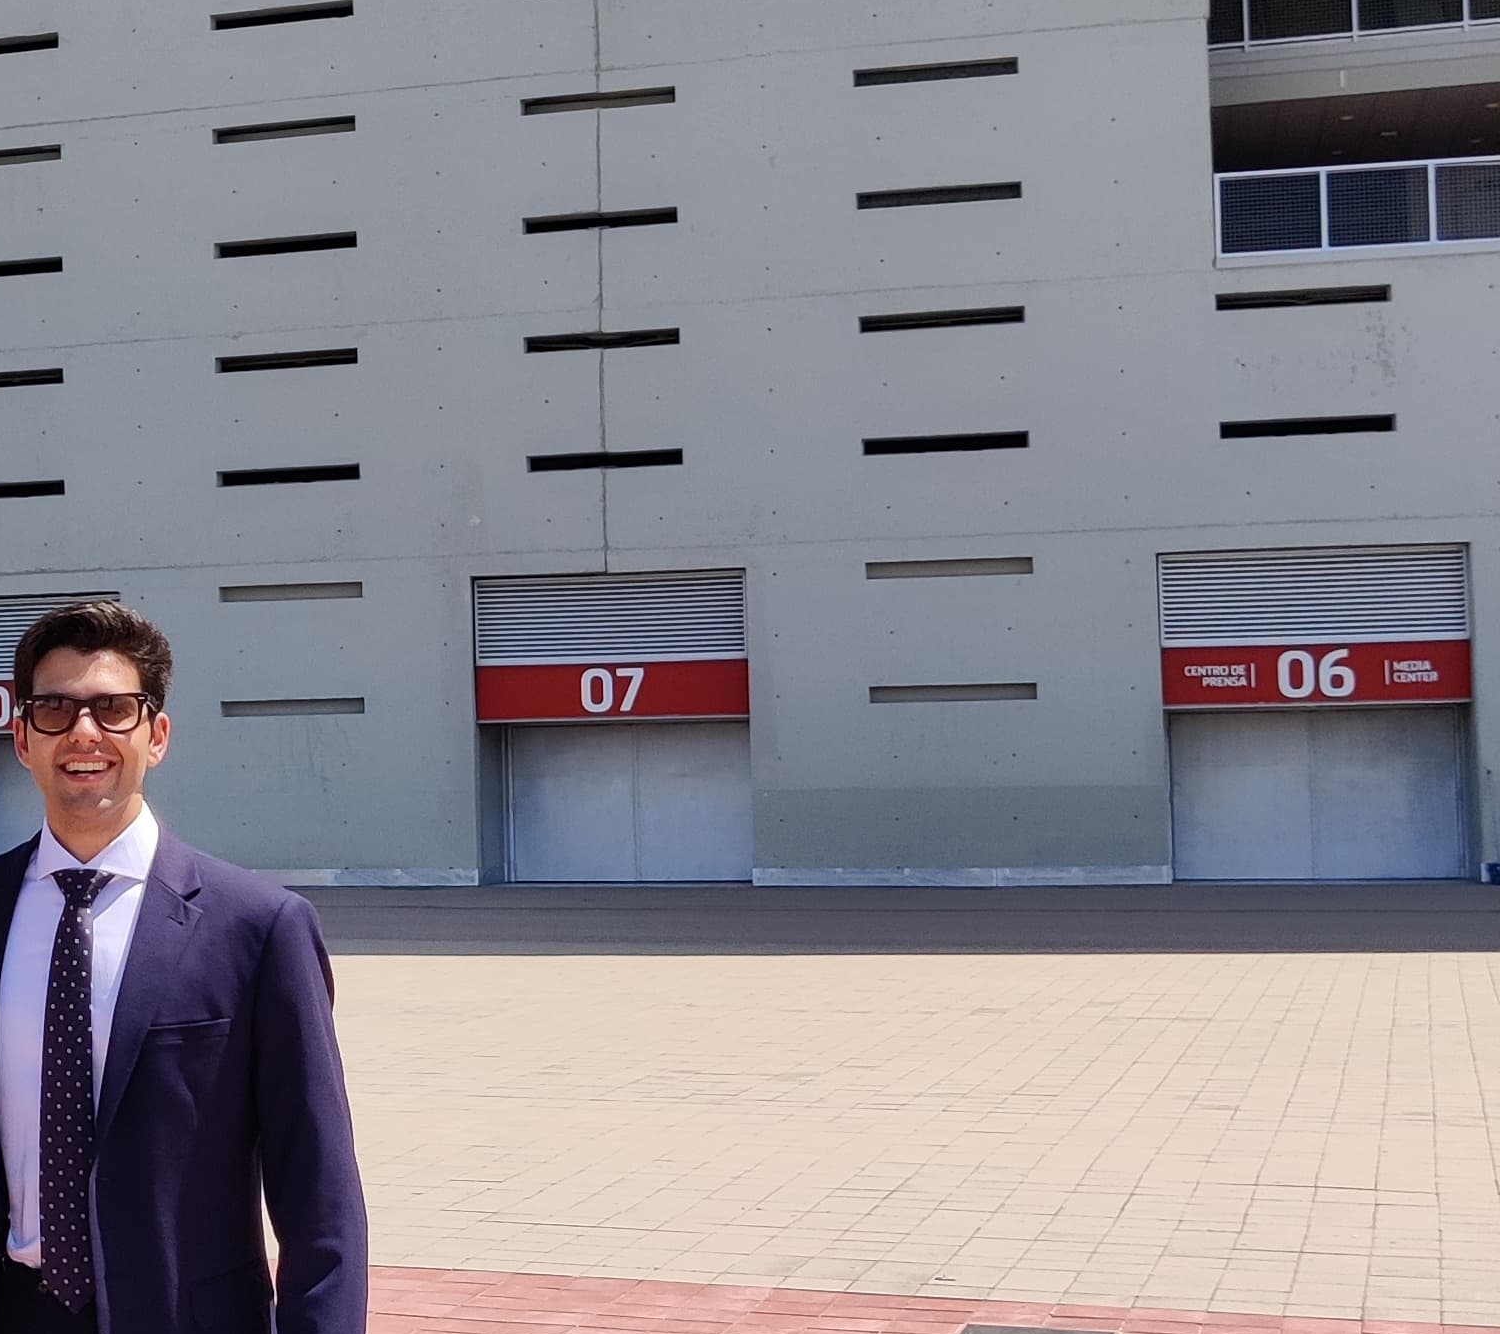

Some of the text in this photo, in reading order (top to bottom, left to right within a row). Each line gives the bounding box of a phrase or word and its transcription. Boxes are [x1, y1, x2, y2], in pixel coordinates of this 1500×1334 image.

[1183, 663, 1246, 677] CENTRO DE
[1392, 659, 1432, 672] MEDIA
[1277, 648, 1356, 698] 06
[1393, 670, 1439, 683] CENTER
[1202, 675, 1247, 687] PRENSA
[580, 667, 645, 713] 07
